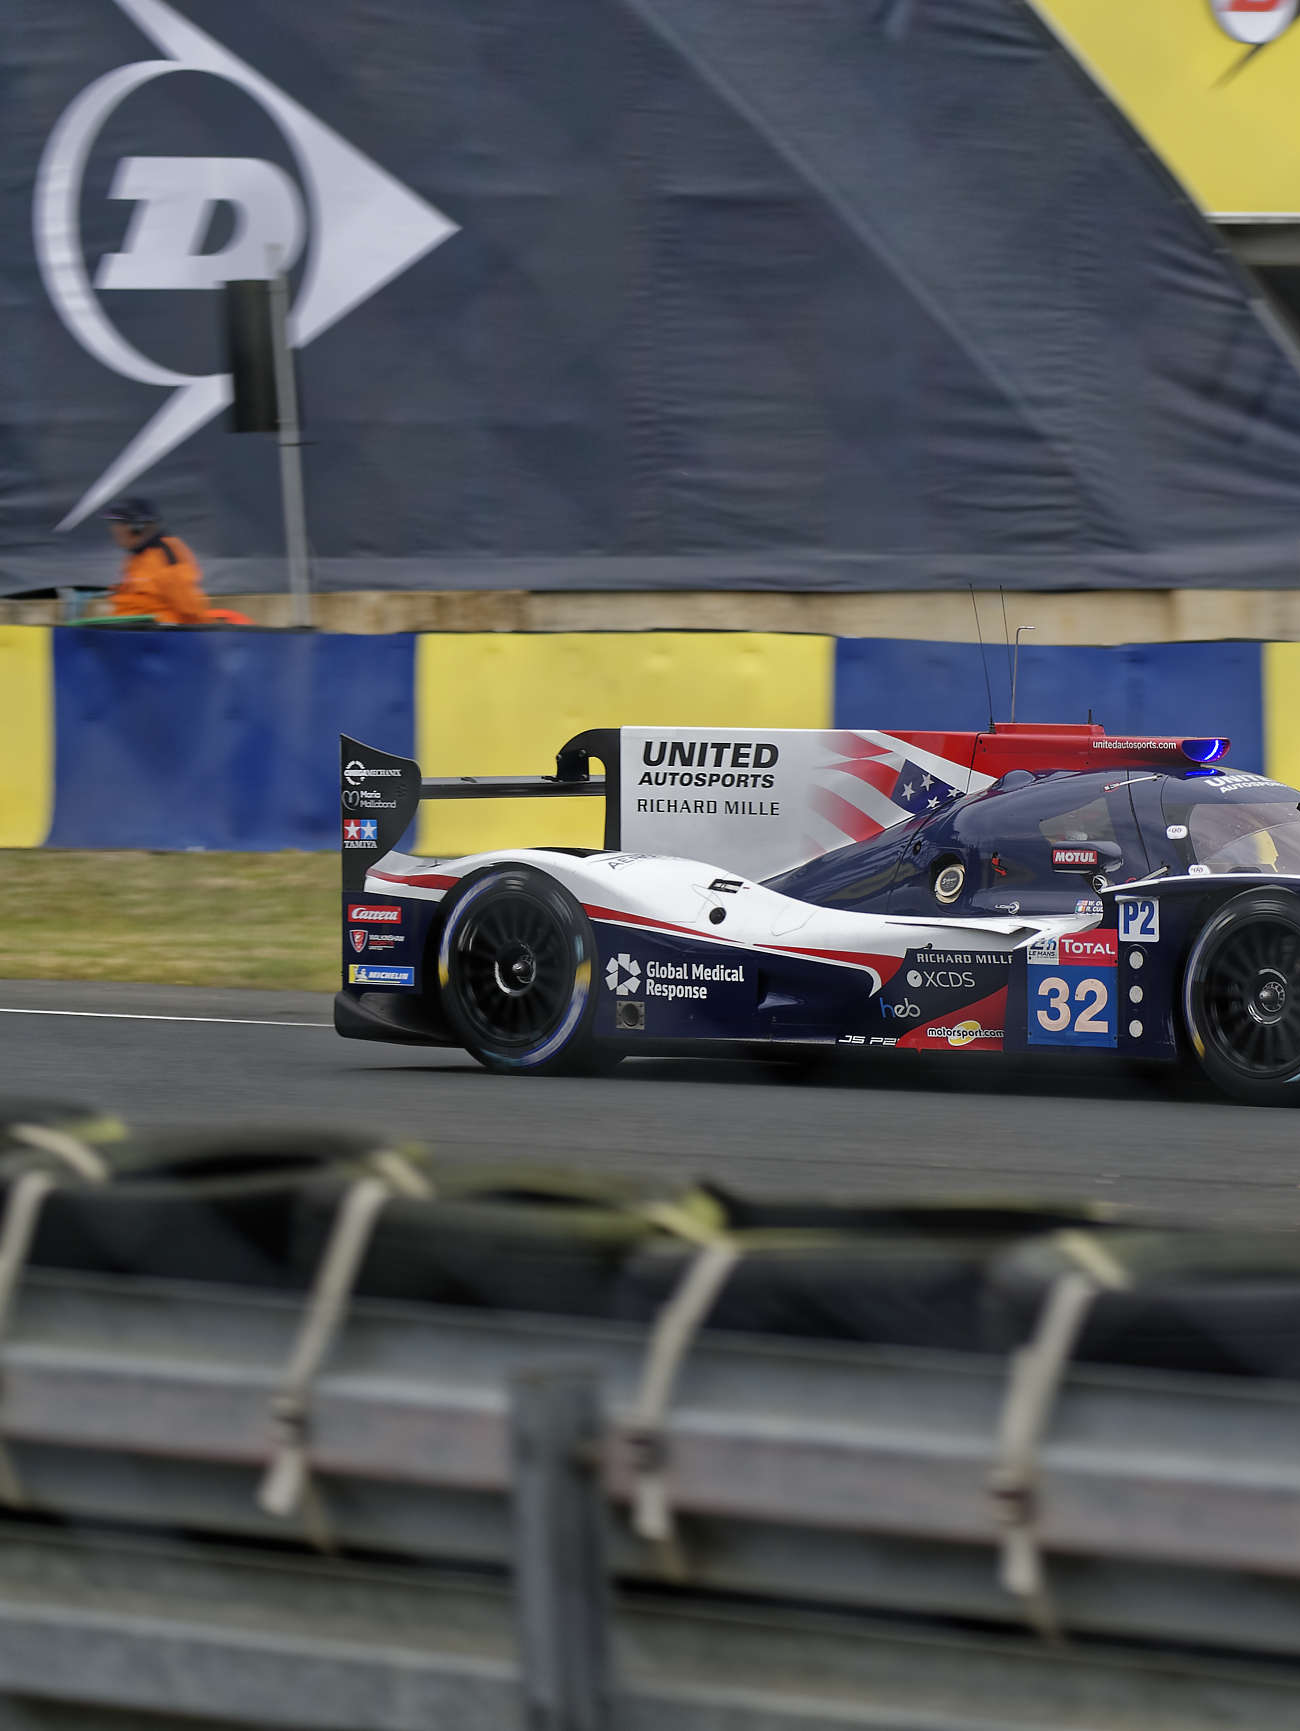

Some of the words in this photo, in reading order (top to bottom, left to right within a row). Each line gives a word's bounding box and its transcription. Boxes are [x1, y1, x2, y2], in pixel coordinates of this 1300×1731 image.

[1093, 740, 1177, 750] unitedautosports.com
[642, 741, 779, 769] UNITED
[638, 771, 775, 789] AUTOSPORTS
[360, 790, 381, 799] Maria
[637, 799, 717, 814] RICHARD
[724, 801, 780, 816] MILLE
[343, 840, 378, 849] TAMIYA
[1055, 852, 1096, 863] MOTUL
[351, 907, 399, 920] Carrera
[1123, 901, 1155, 935] P2
[1061, 939, 1116, 955] TOTAL
[917, 953, 972, 964] RICHARD
[368, 971, 409, 980] MICHELIN
[646, 961, 689, 980] Global
[691, 963, 745, 982] Medical
[923, 971, 976, 988] XCDS
[646, 979, 707, 1000] Response
[879, 997, 921, 1018] heb
[1036, 977, 1109, 1033] 32
[838, 1034, 866, 1044] JS
[927, 1026, 1005, 1038] motorsport.com
